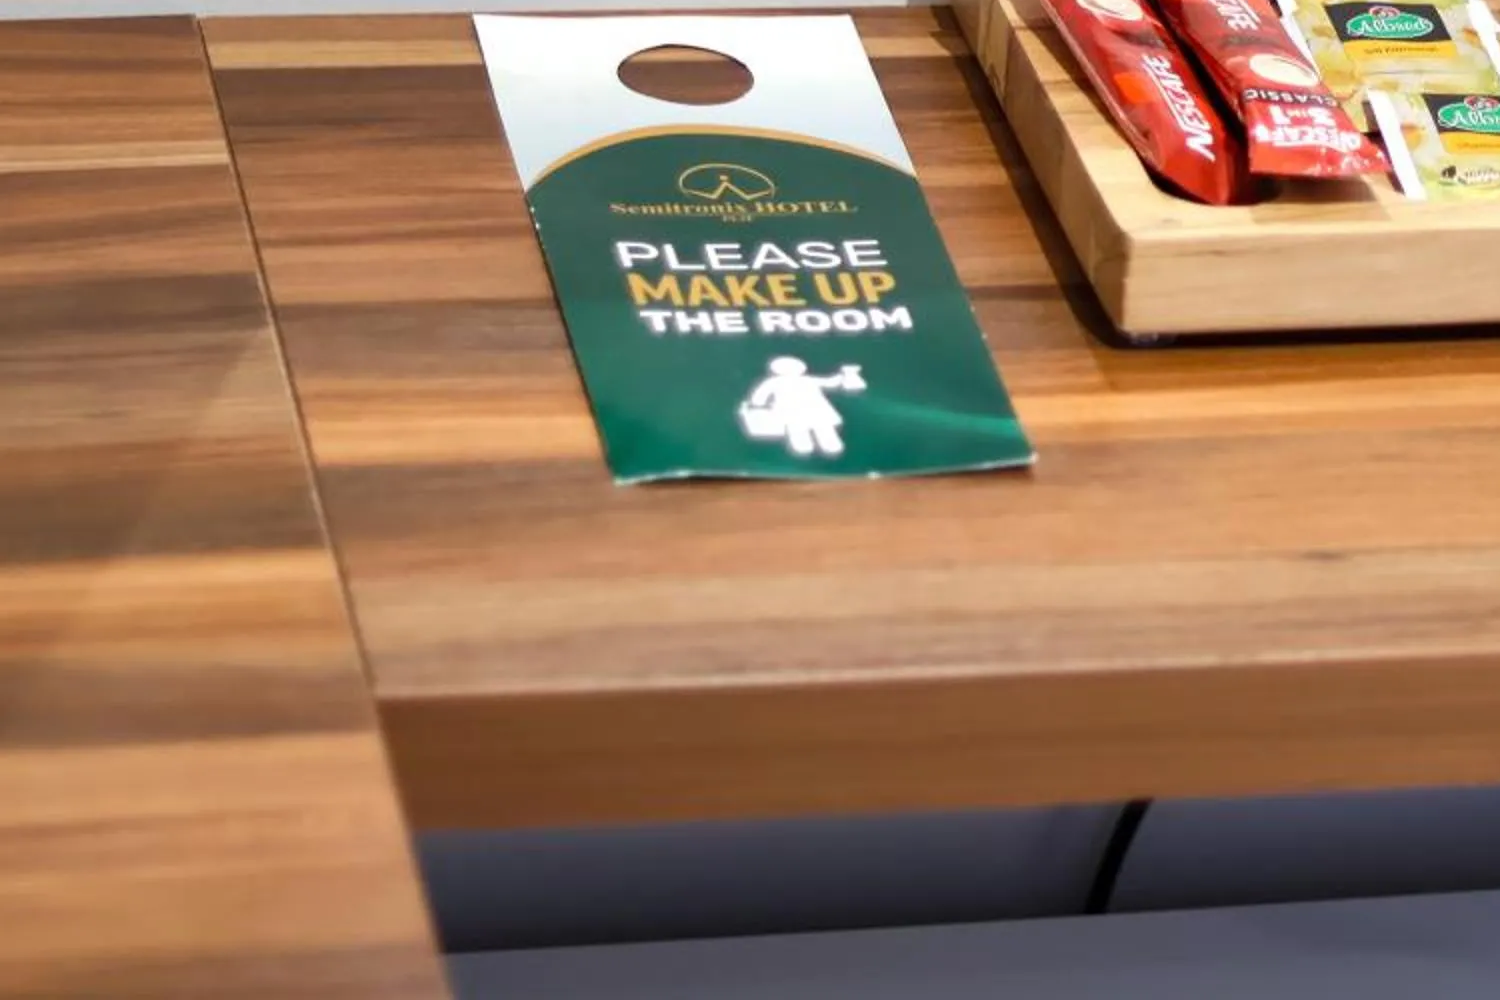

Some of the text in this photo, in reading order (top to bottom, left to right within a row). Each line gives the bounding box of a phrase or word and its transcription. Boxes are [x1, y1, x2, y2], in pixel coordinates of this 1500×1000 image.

[1243, 88, 1337, 107] CLASSIC
[754, 199, 860, 214] HOTEL
[615, 239, 888, 271] PLEASE
[626, 270, 897, 307] MAKE UP
[639, 306, 914, 334] THE ROOM
